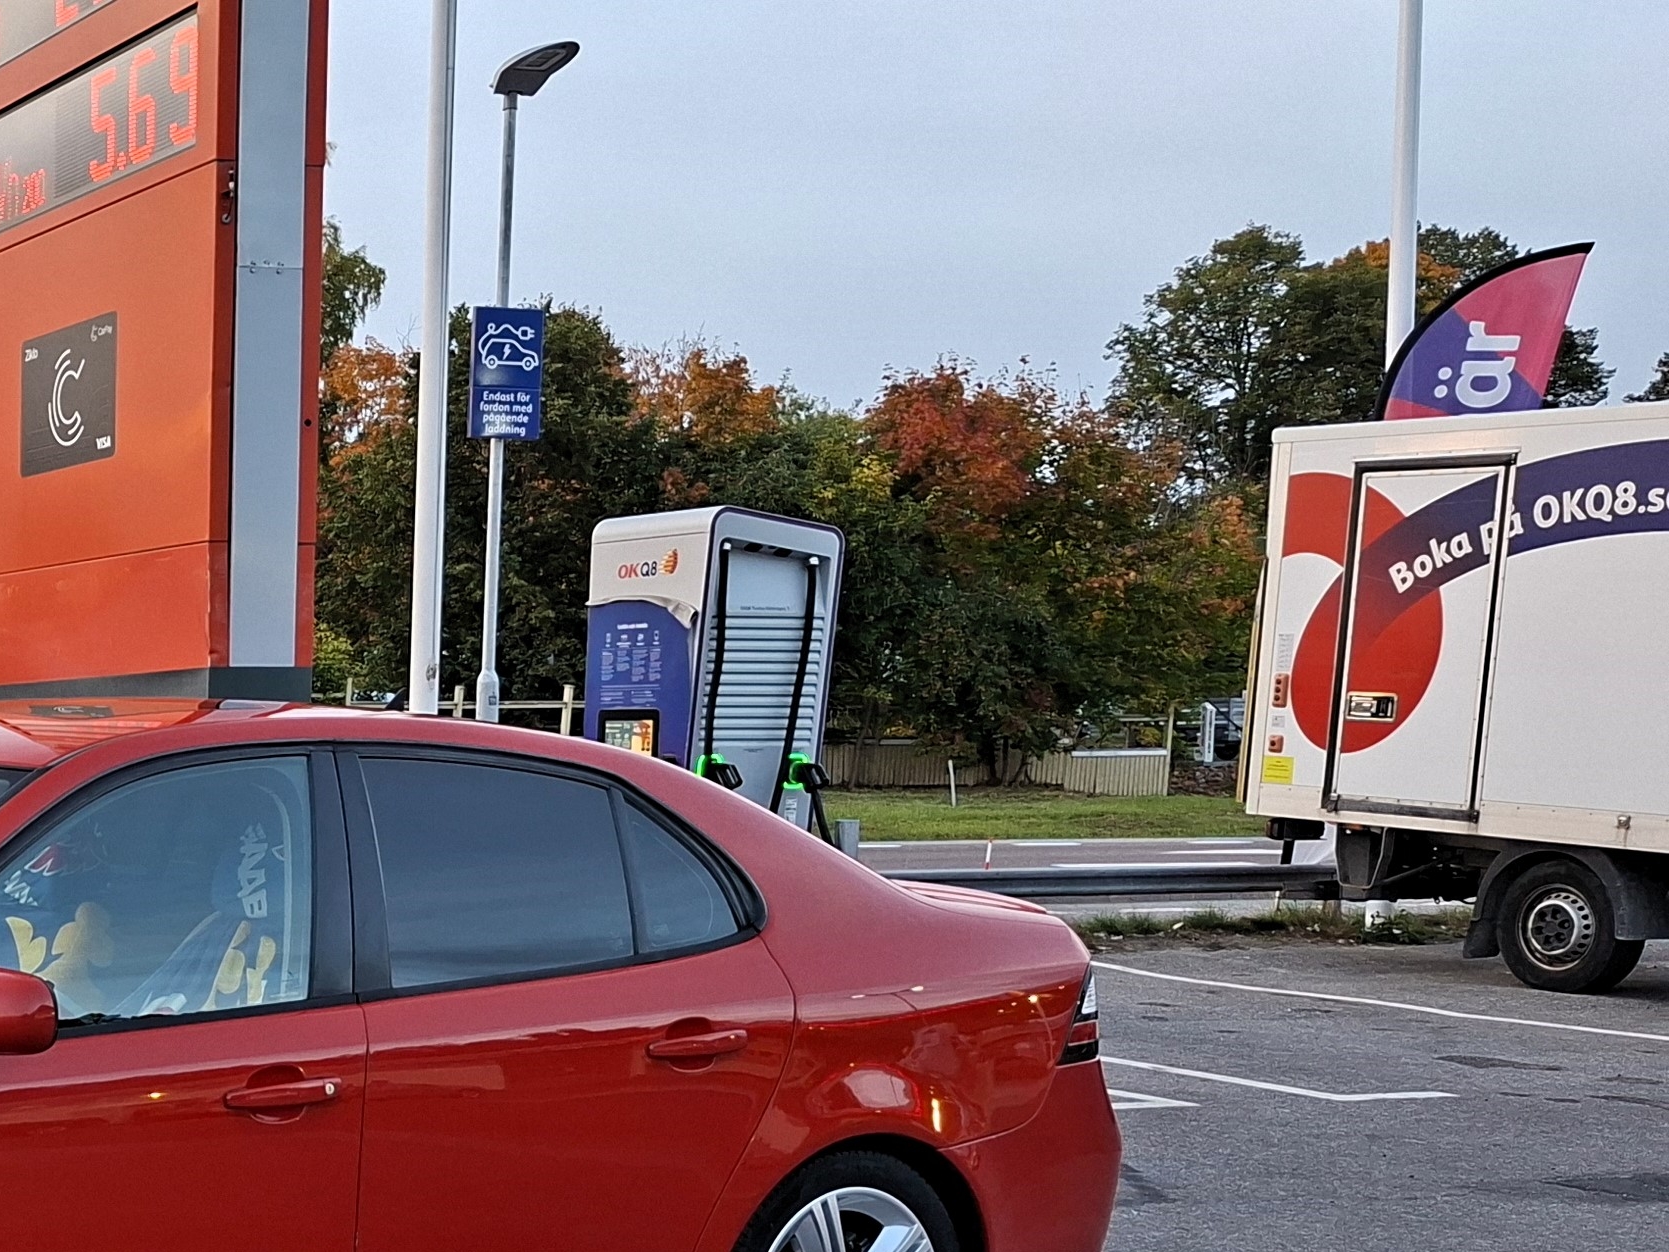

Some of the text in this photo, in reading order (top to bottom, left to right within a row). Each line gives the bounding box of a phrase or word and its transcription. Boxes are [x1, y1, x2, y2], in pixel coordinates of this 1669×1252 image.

[88, 25, 199, 183] 5.69
[483, 391, 531, 402] Endast för
[479, 401, 533, 413] fordon med
[482, 412, 529, 424] pågående
[484, 423, 526, 437] laddning
[1388, 532, 1474, 594] Boka
[1533, 481, 1669, 529] OKQ8.s
[617, 561, 658, 579] OKQ8
